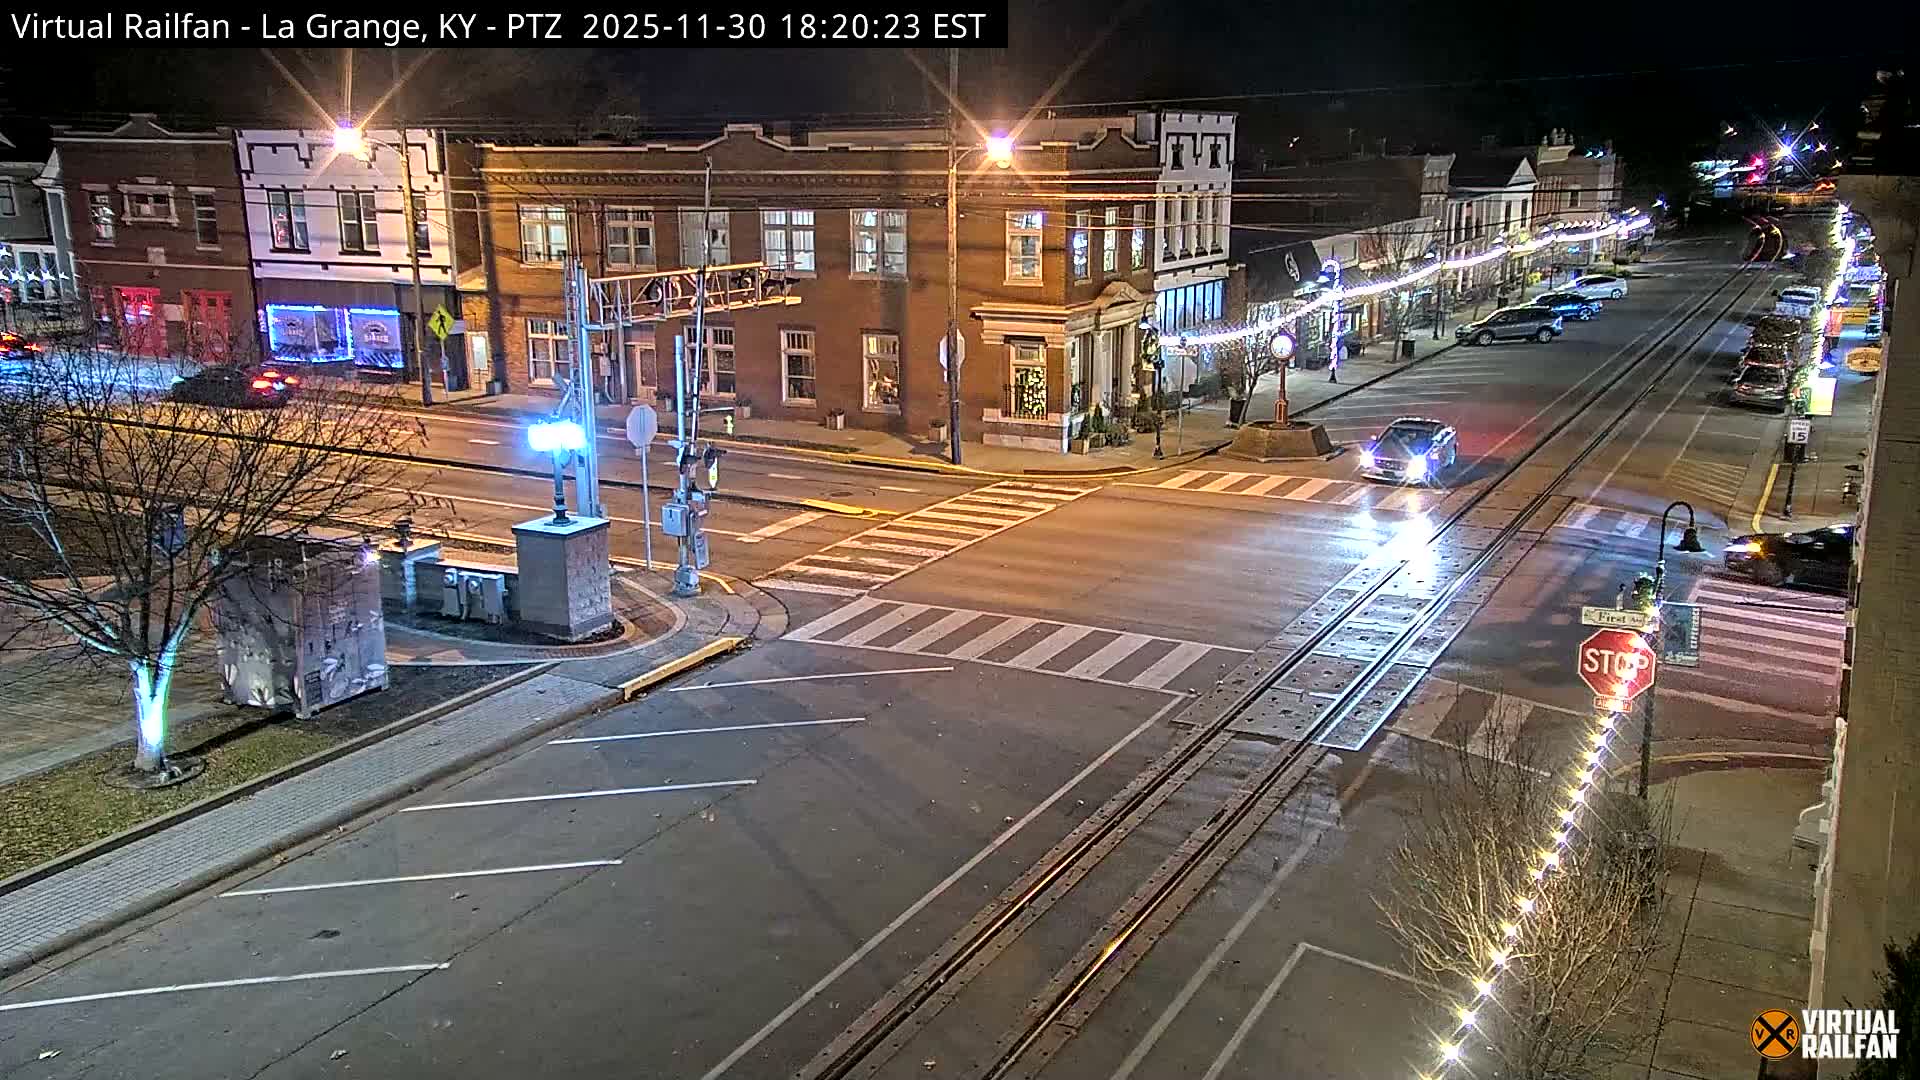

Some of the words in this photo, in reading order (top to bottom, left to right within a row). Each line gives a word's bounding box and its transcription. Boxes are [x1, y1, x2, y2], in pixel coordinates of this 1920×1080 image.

[1792, 431, 1807, 441] 15
[1598, 610, 1626, 624] First
[1583, 647, 1649, 676] STOP
